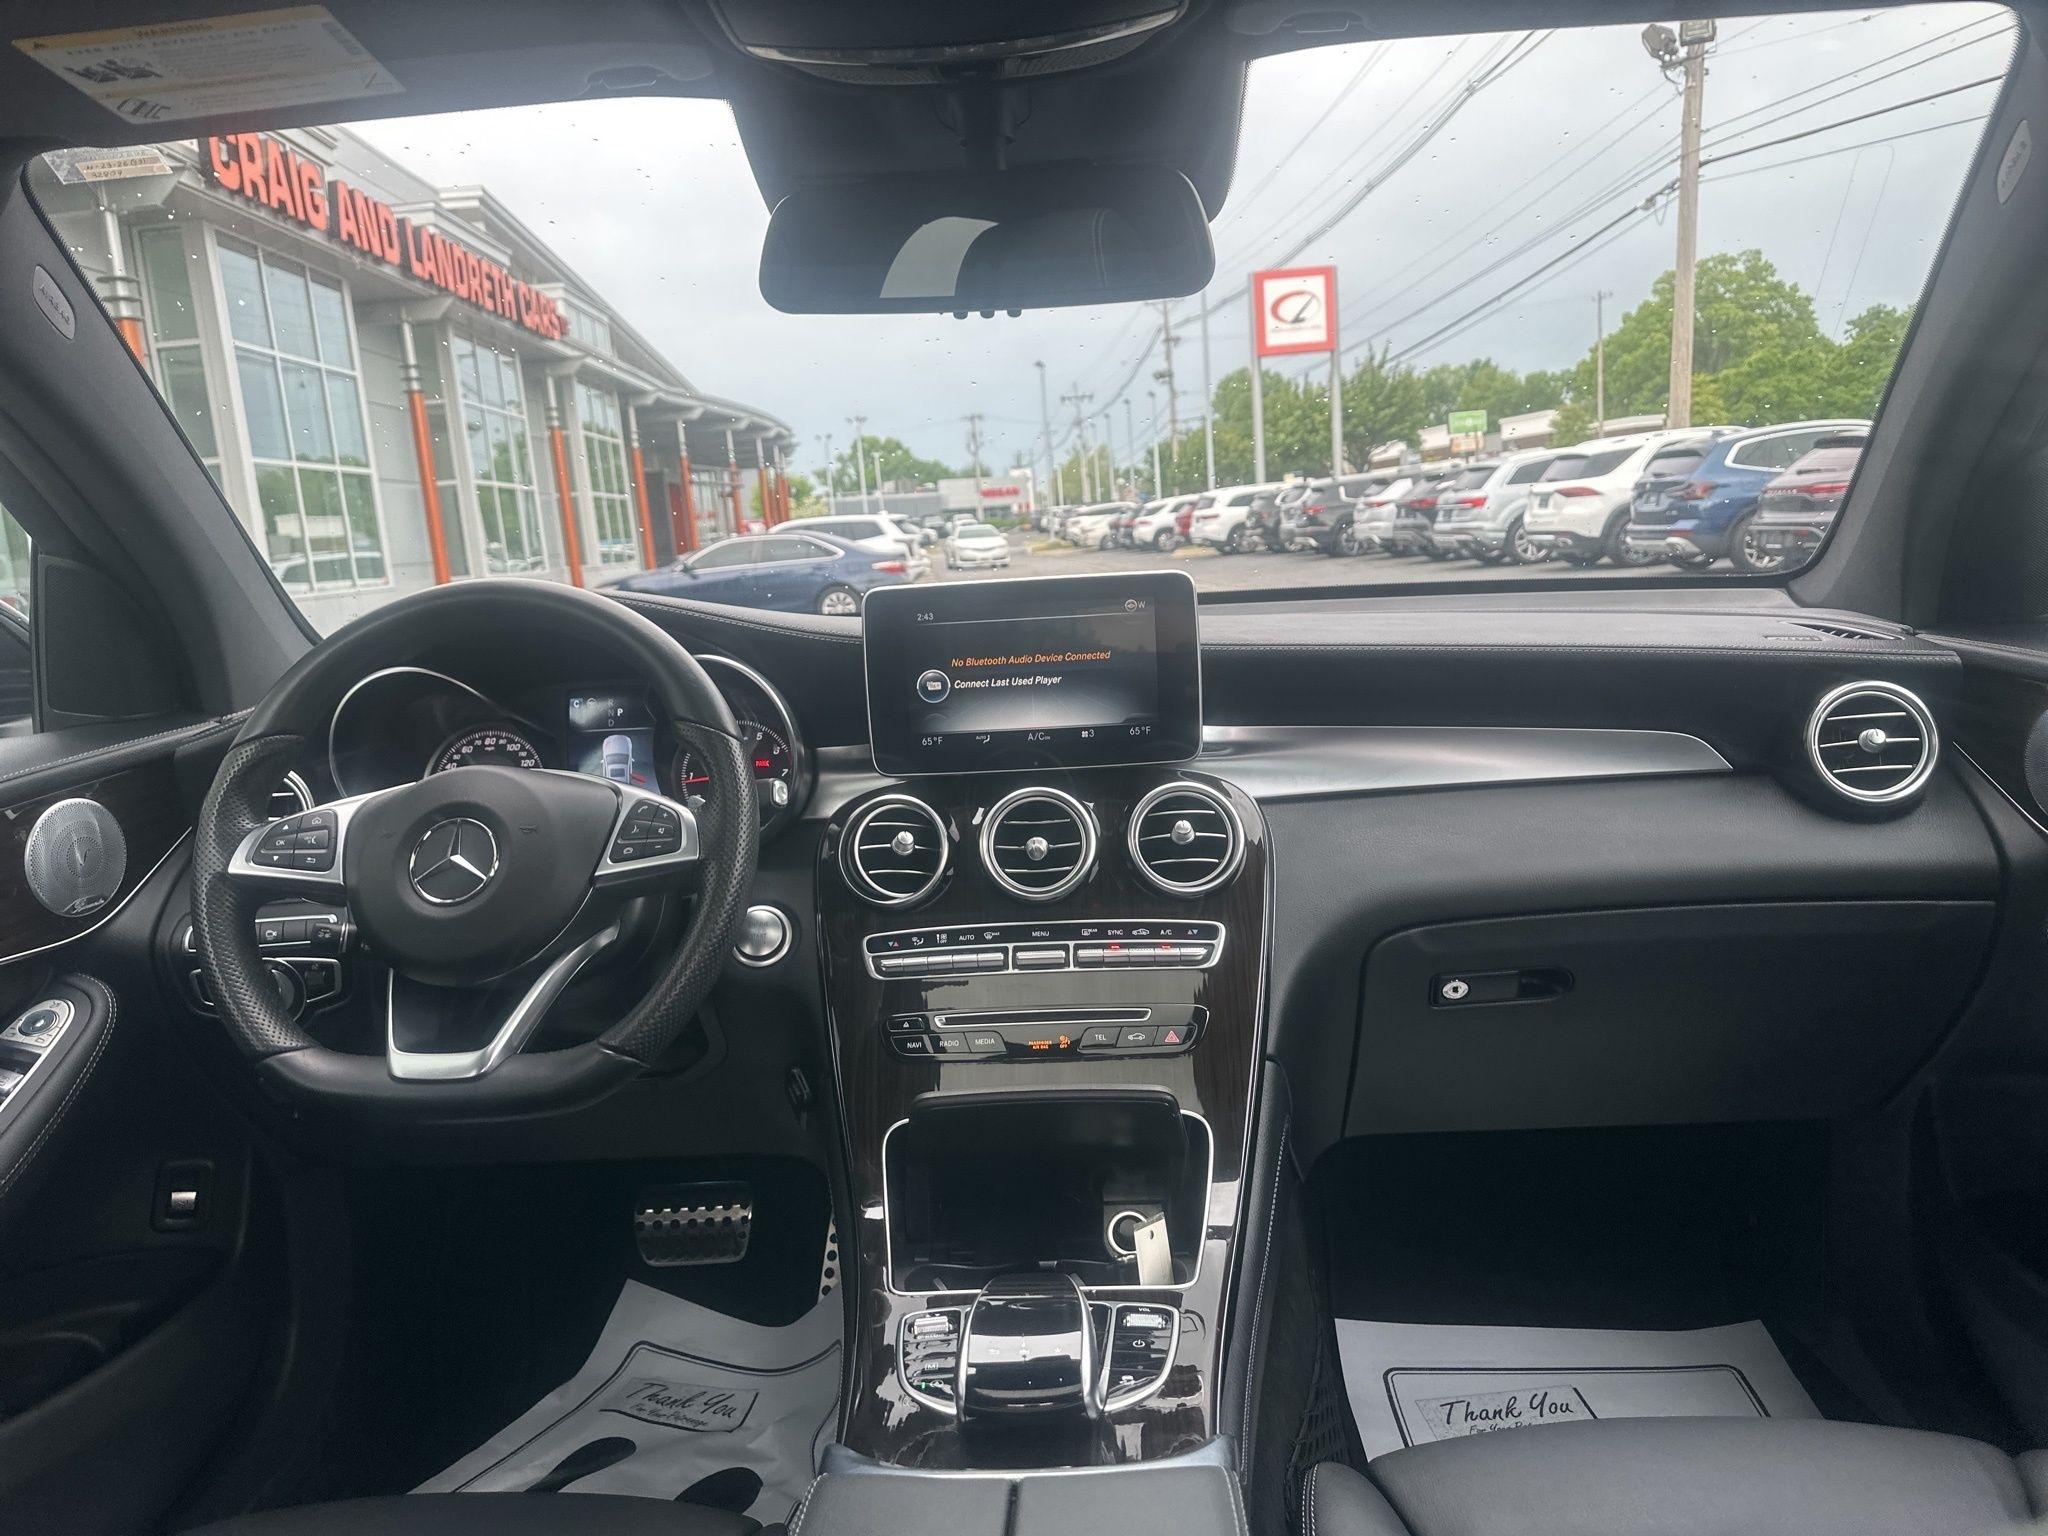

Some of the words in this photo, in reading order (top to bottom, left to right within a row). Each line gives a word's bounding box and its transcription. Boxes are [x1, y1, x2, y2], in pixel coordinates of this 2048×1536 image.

[209, 133, 328, 231] CRAIG
[337, 180, 399, 264] AND
[404, 218, 517, 321] LANDRETH
[517, 280, 568, 340] CARS
[1137, 600, 1146, 608] W
[917, 612, 934, 621] 2:43
[951, 658, 964, 668] No
[965, 656, 1007, 667] Bluetooth
[1008, 654, 1033, 664] Audio
[1034, 652, 1063, 663] Device
[1064, 650, 1111, 661] Connected
[954, 680, 989, 689] Connect
[991, 677, 1010, 687] Last
[1011, 676, 1034, 686] Used
[1035, 675, 1062, 686] Player
[617, 707, 624, 717] P
[608, 719, 615, 728] D
[1088, 728, 1095, 738] 3
[1129, 725, 1151, 736] 65°F
[756, 731, 763, 741] 5
[1027, 731, 1045, 741] A/C
[484, 737, 497, 745] 80
[921, 736, 943, 746] 65°F
[461, 745, 474, 754] 60
[506, 743, 521, 752] 100
[445, 762, 457, 770] 40
[520, 759, 535, 767] 120
[781, 768, 789, 777] 7
[906, 1041, 922, 1049] NAVI
[939, 1040, 960, 1048] RADIO
[626, 1382, 708, 1409] Thank
[700, 1393, 737, 1419] You
[1440, 1396, 1523, 1425] Thank
[1529, 1391, 1574, 1418] You
